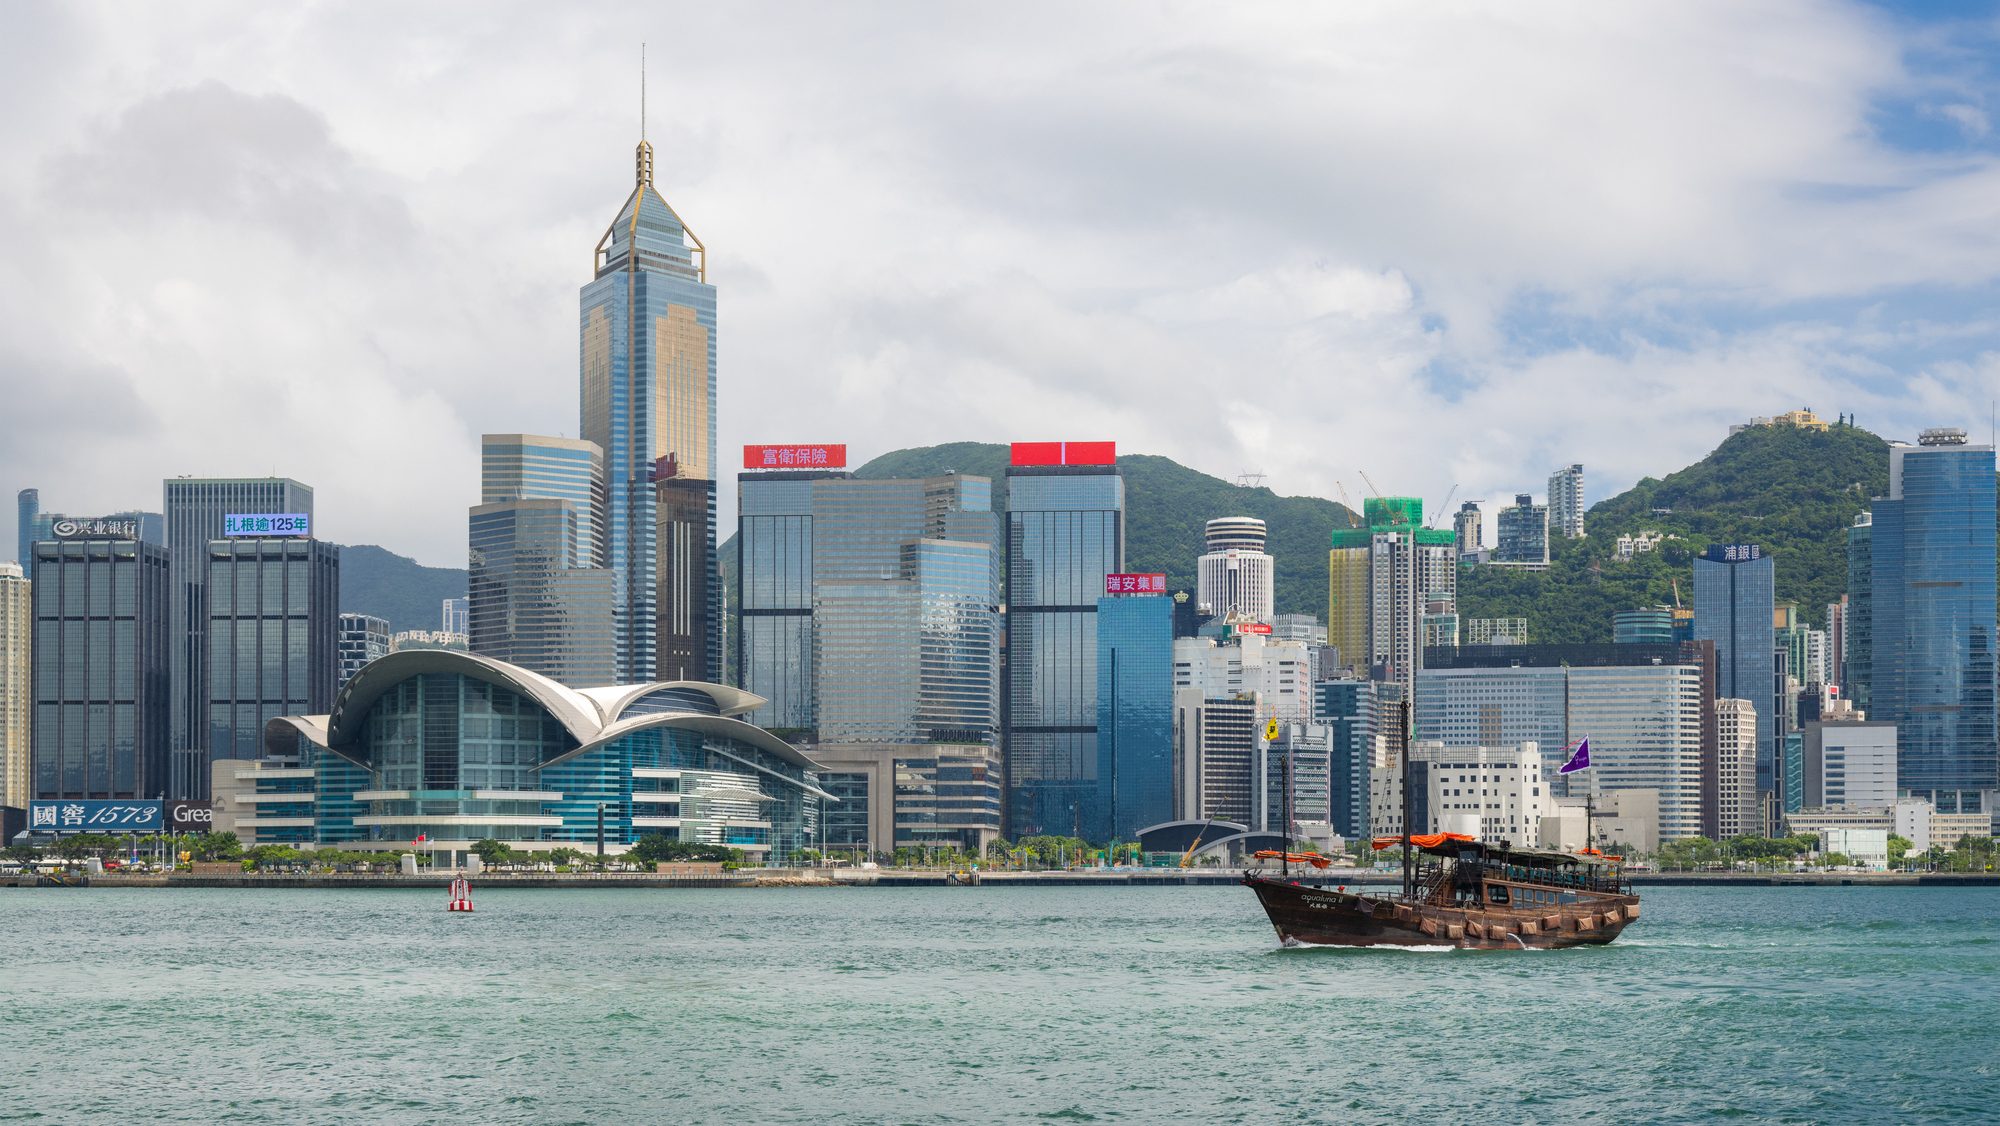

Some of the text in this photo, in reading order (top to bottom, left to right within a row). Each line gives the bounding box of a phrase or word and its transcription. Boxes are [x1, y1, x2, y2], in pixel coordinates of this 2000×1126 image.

[763, 448, 827, 465] 富衛保險
[78, 520, 136, 537] 兴业银行
[227, 517, 307, 532] 扎根逾125年
[1107, 576, 1165, 591] 瑞安集團
[88, 806, 158, 824] 1573
